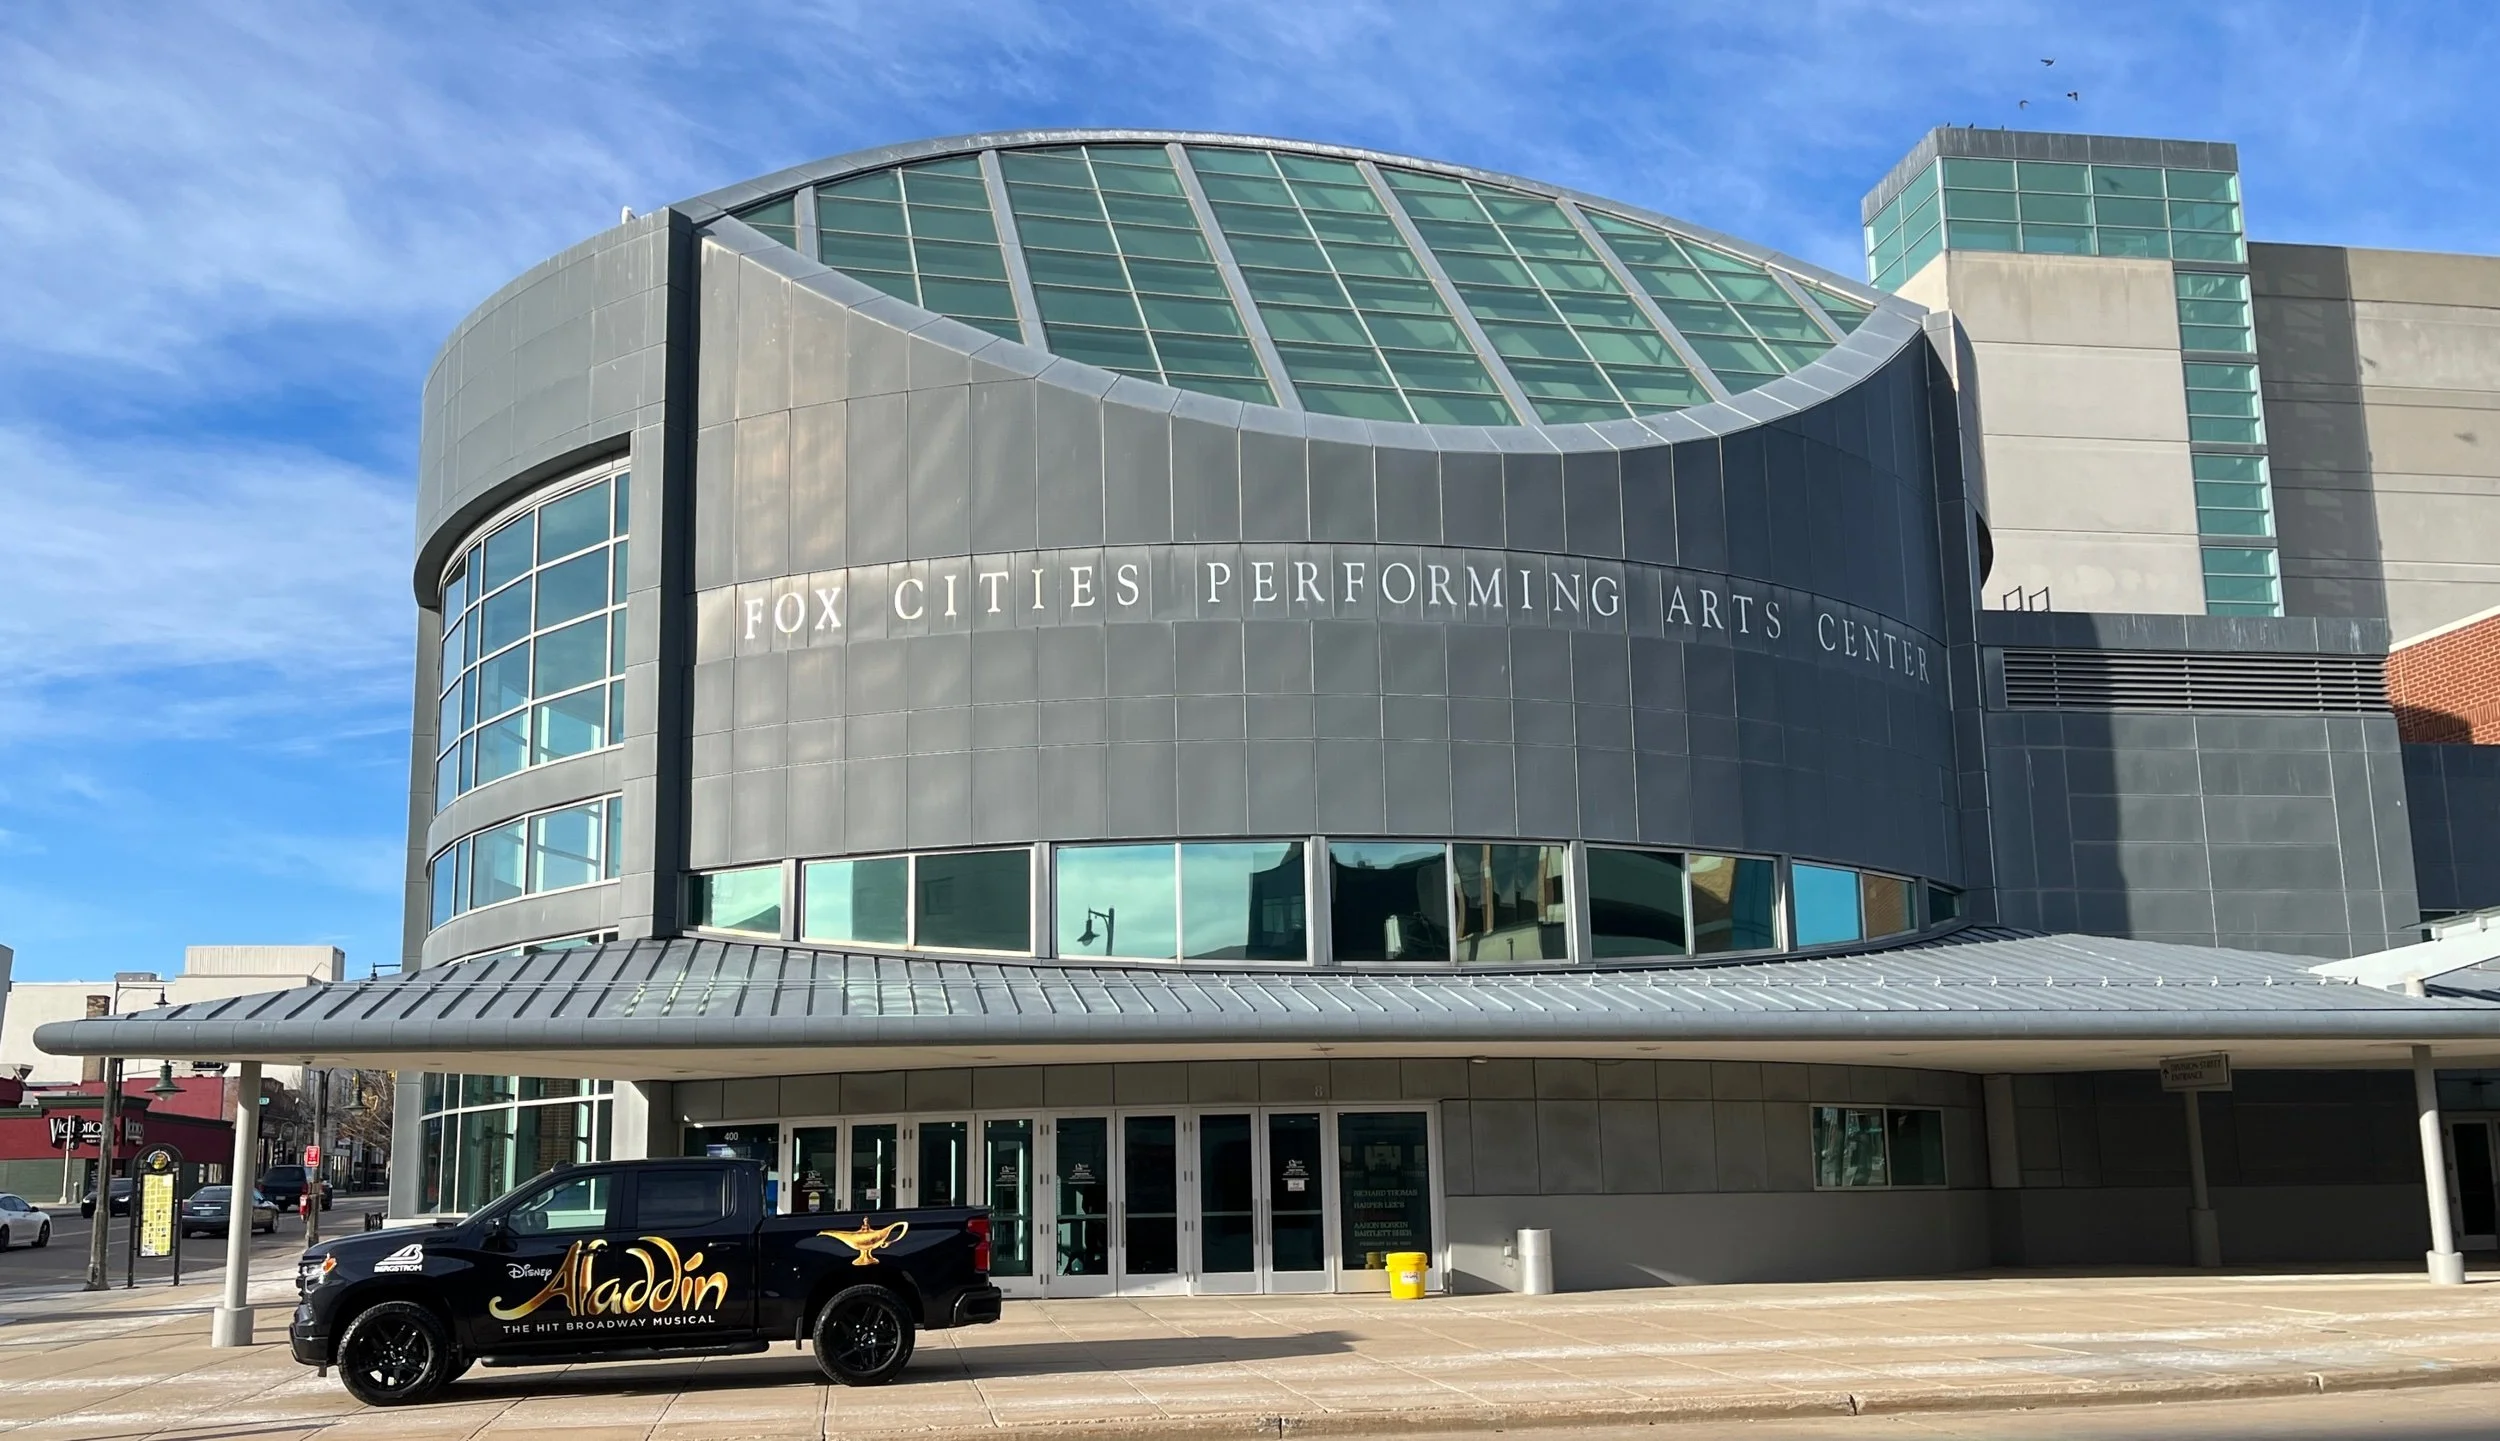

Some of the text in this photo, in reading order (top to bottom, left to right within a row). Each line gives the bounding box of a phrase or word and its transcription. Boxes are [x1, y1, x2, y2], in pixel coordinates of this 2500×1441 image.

[743, 561, 1931, 685] FOX CITIES PERFORMING ARTS CENTER
[724, 1131, 739, 1141] 400
[373, 1264, 423, 1273] BERGSTROM
[488, 1236, 729, 1320] Aladdin
[503, 1314, 715, 1334] THE HIT BROADWAY MUSICAL
